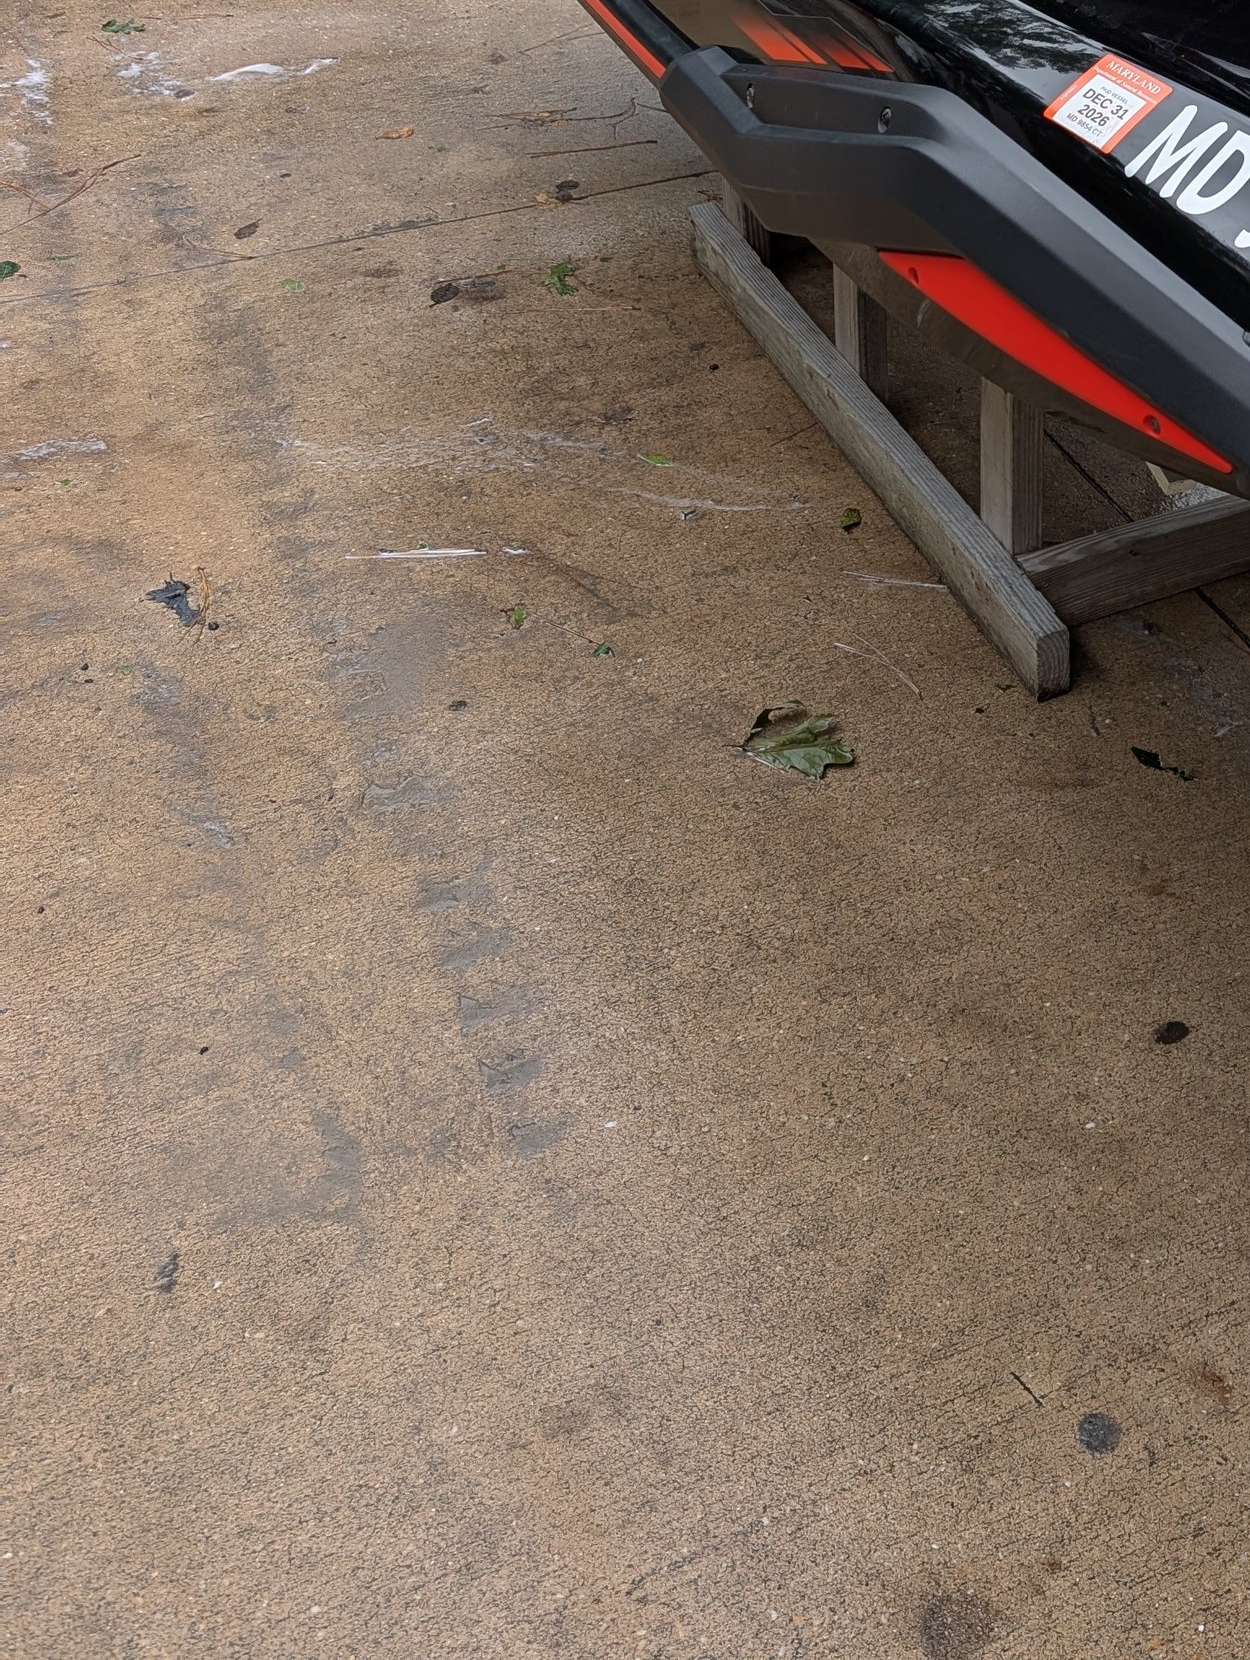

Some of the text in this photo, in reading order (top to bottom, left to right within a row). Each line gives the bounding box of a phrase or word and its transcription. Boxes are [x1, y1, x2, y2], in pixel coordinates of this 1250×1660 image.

[1106, 60, 1161, 94] MARYLAND
[1077, 104, 1110, 127] 2026
[1082, 88, 1113, 109] DEC
[1110, 104, 1129, 120] 31
[1066, 112, 1103, 138] MD 9854 CT
